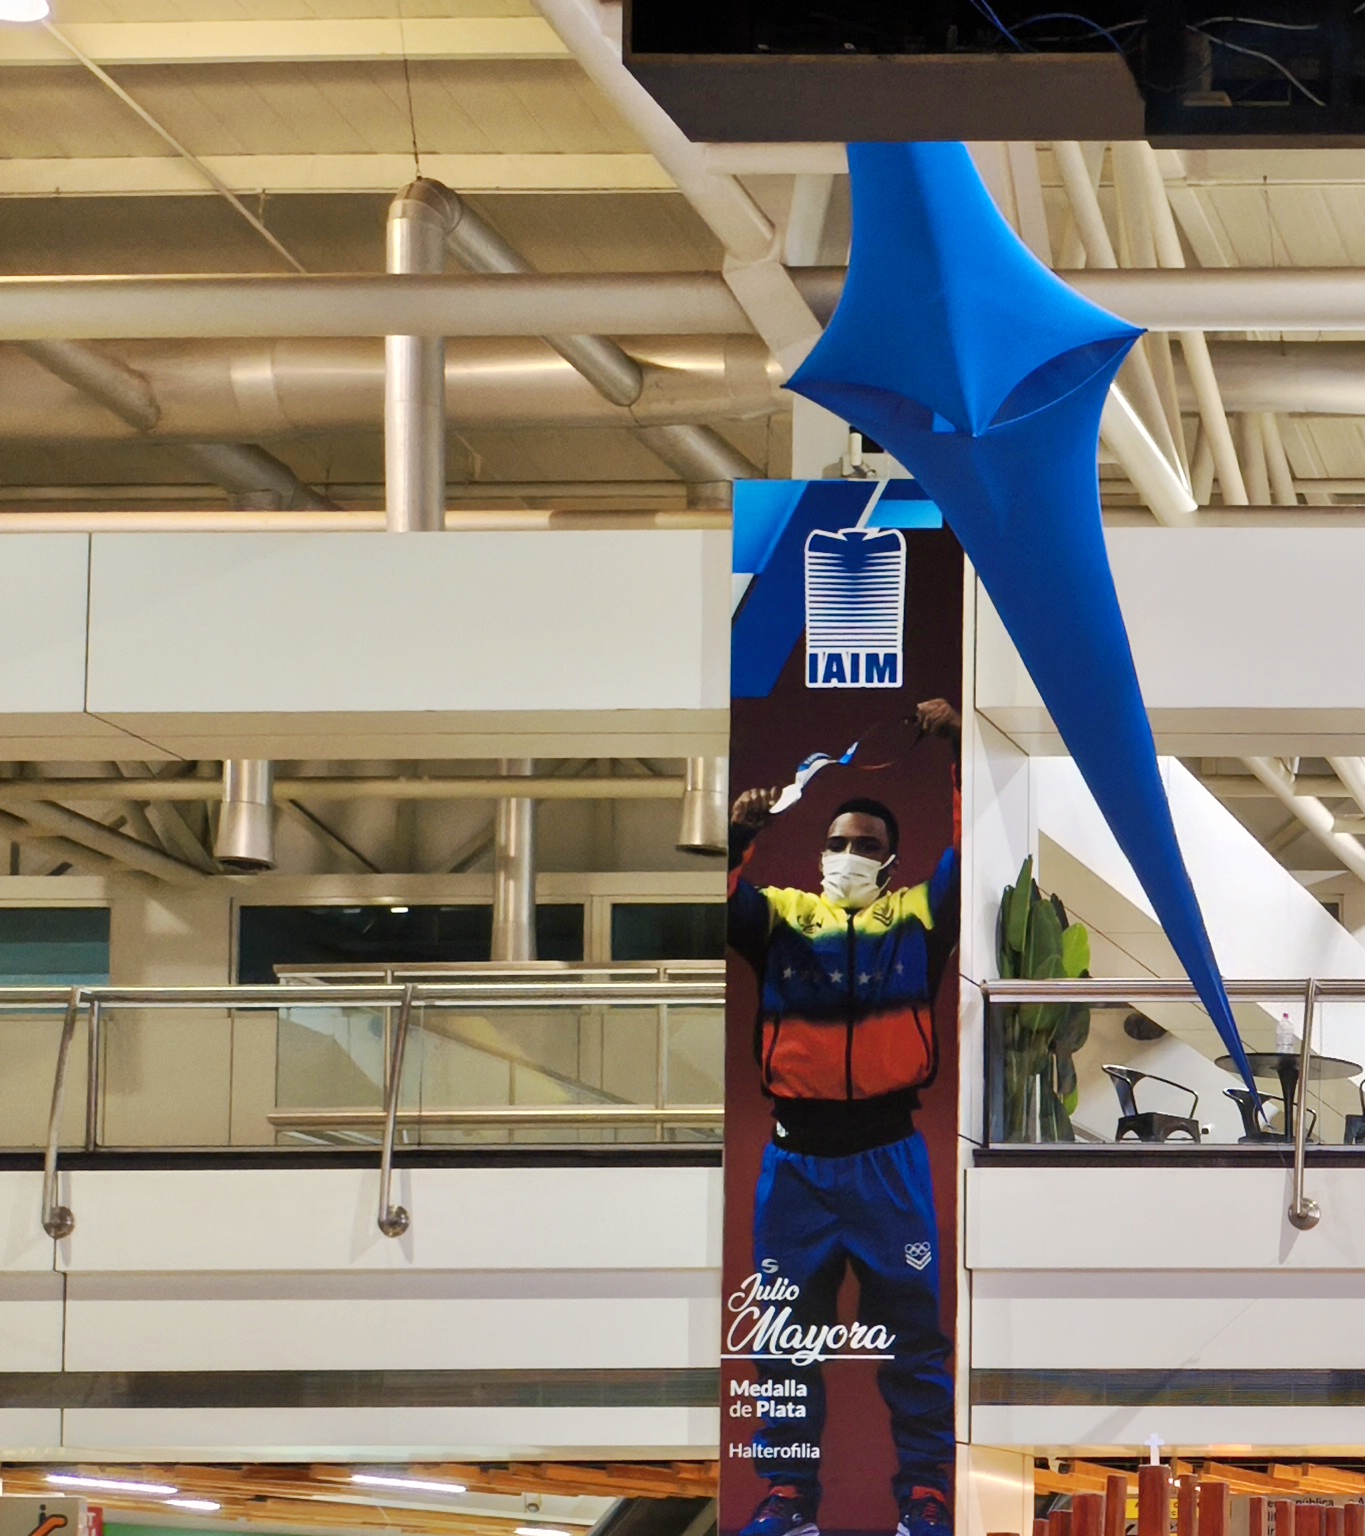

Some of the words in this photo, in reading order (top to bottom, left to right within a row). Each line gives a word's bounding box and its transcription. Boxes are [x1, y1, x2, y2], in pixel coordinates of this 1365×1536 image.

[808, 652, 899, 684] IAIM
[727, 1273, 800, 1312] Julio
[727, 1306, 896, 1366] Mayora
[729, 1380, 808, 1397] Medalla
[729, 1401, 753, 1418] de
[756, 1401, 807, 1418] Plata
[728, 1443, 821, 1459] Halterofilia
